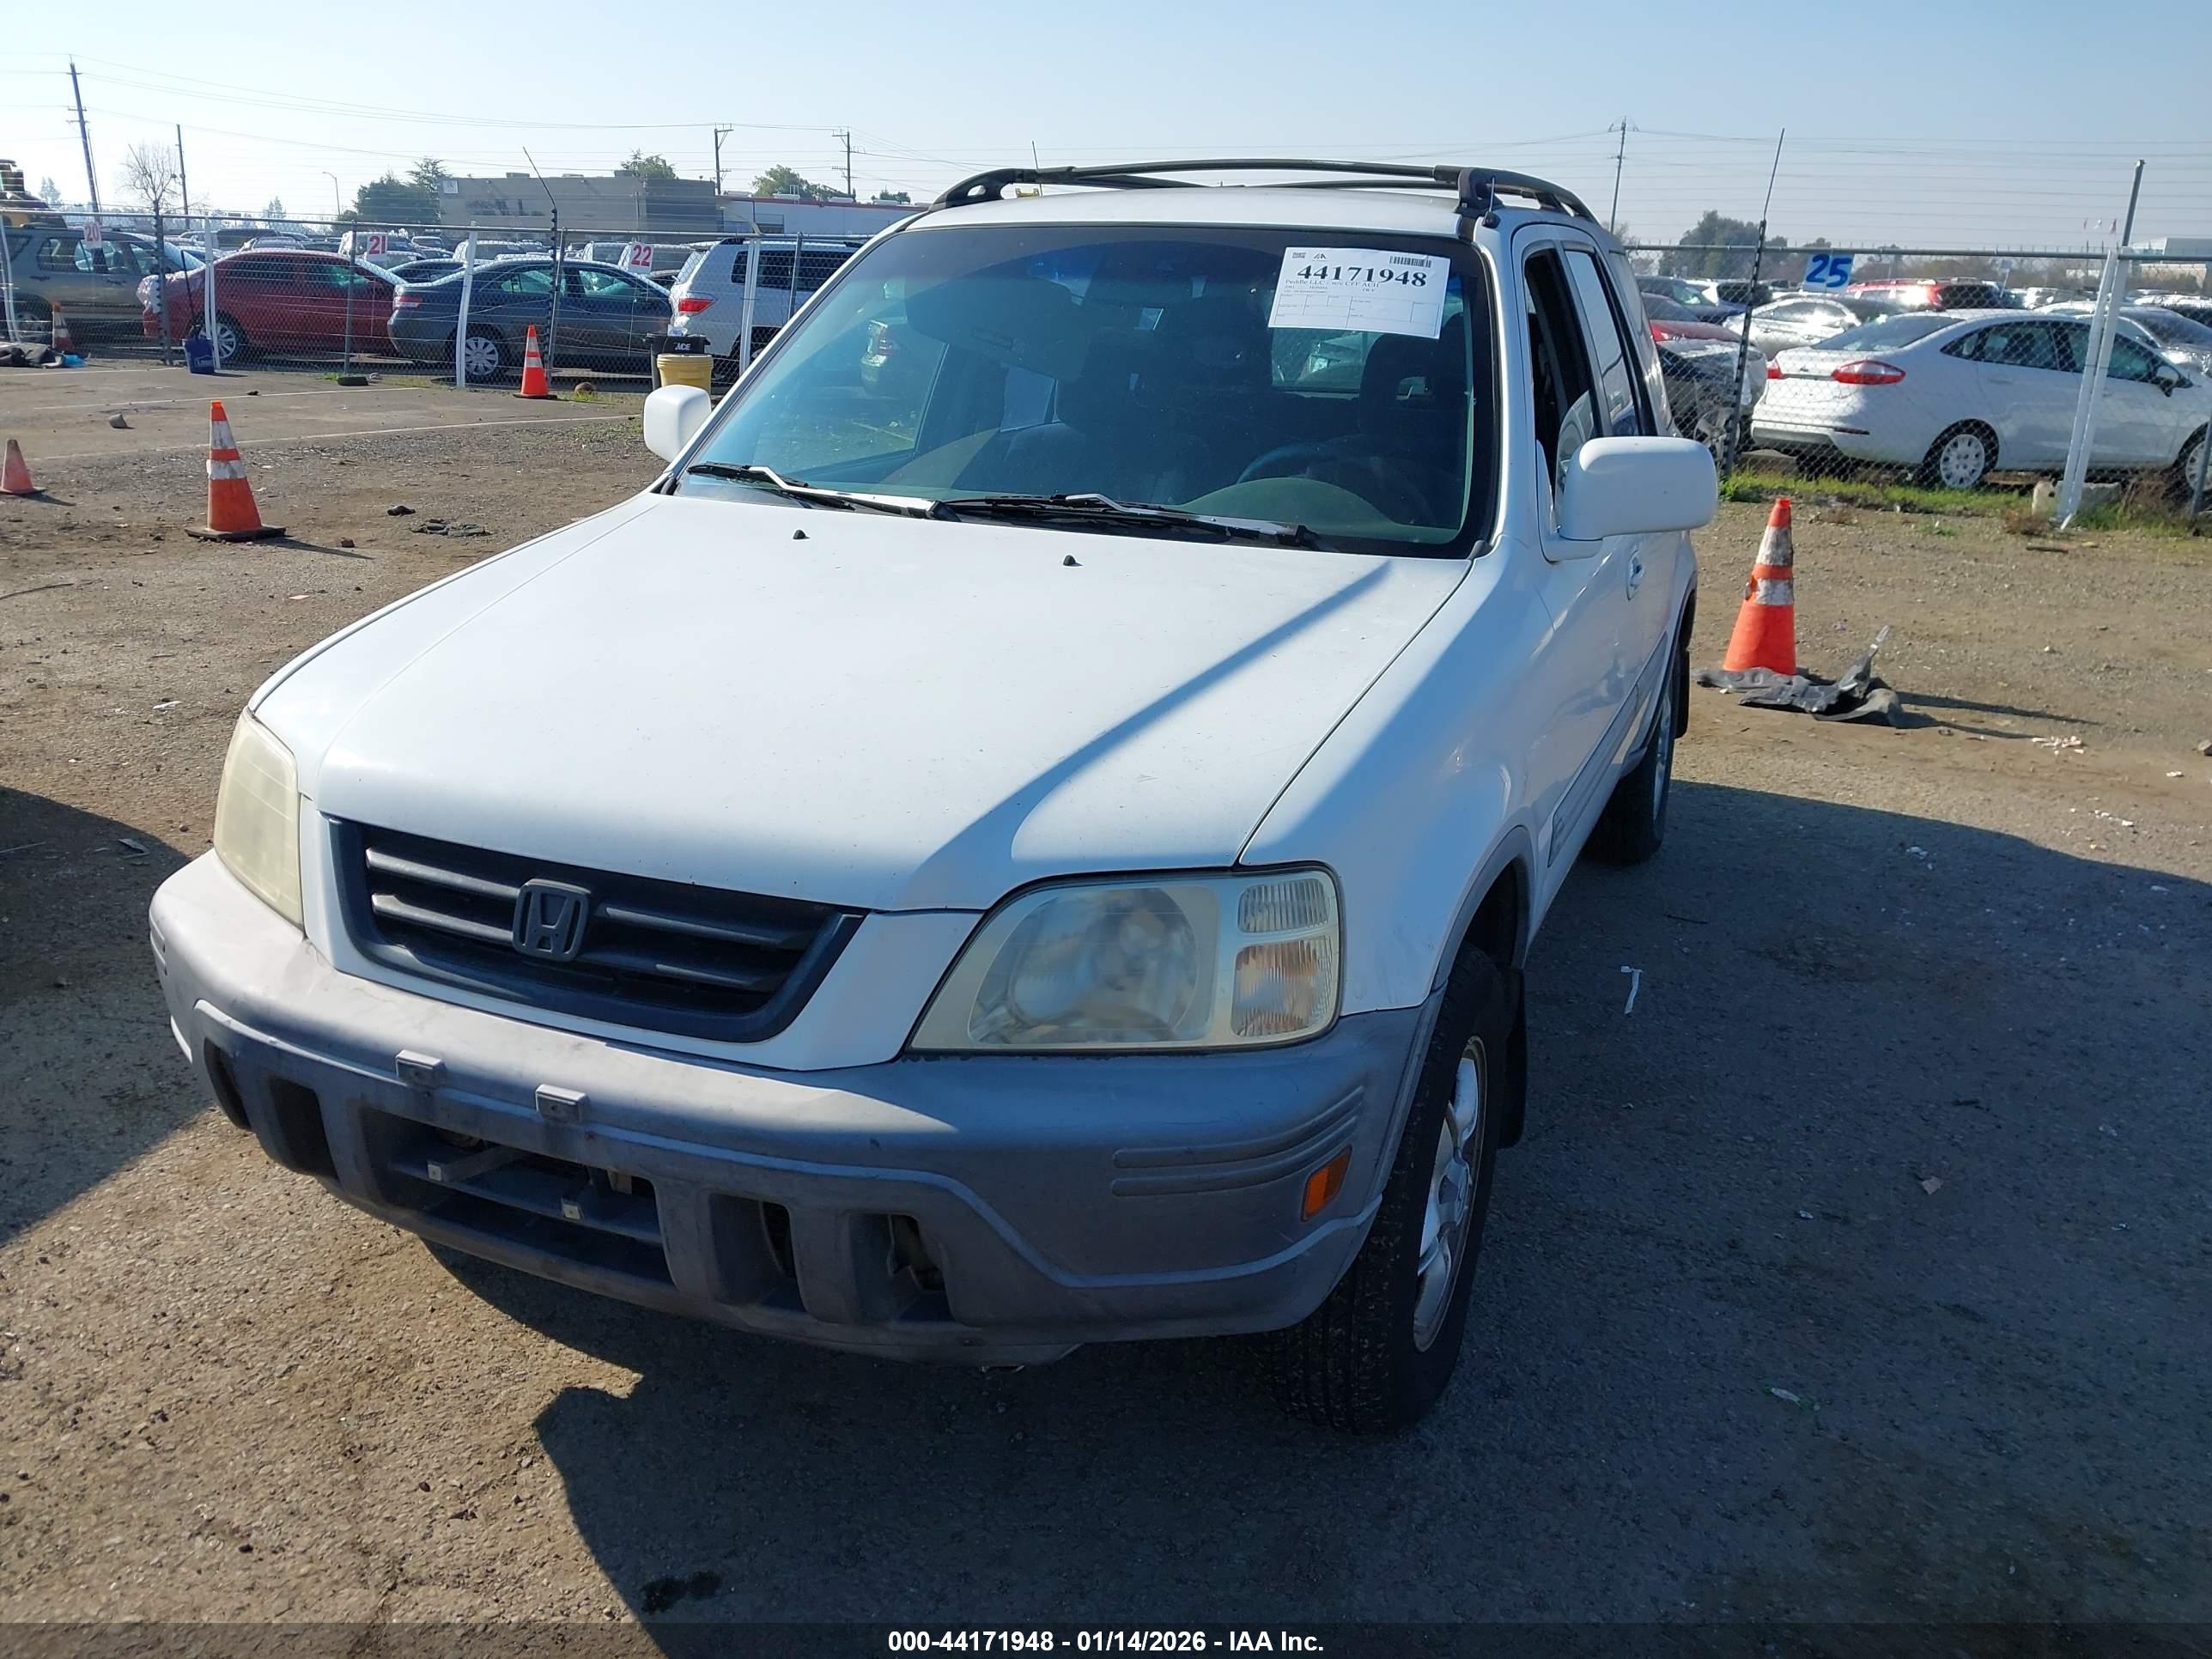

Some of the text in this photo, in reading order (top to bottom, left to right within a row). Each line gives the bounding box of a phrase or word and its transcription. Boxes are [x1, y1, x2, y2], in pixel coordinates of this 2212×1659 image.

[85, 225, 100, 242] 20
[368, 235, 386, 255] 21
[631, 245, 652, 267] 22
[1297, 264, 1428, 288] 44171948
[1806, 253, 1852, 288] 25
[674, 343, 691, 351] ACE
